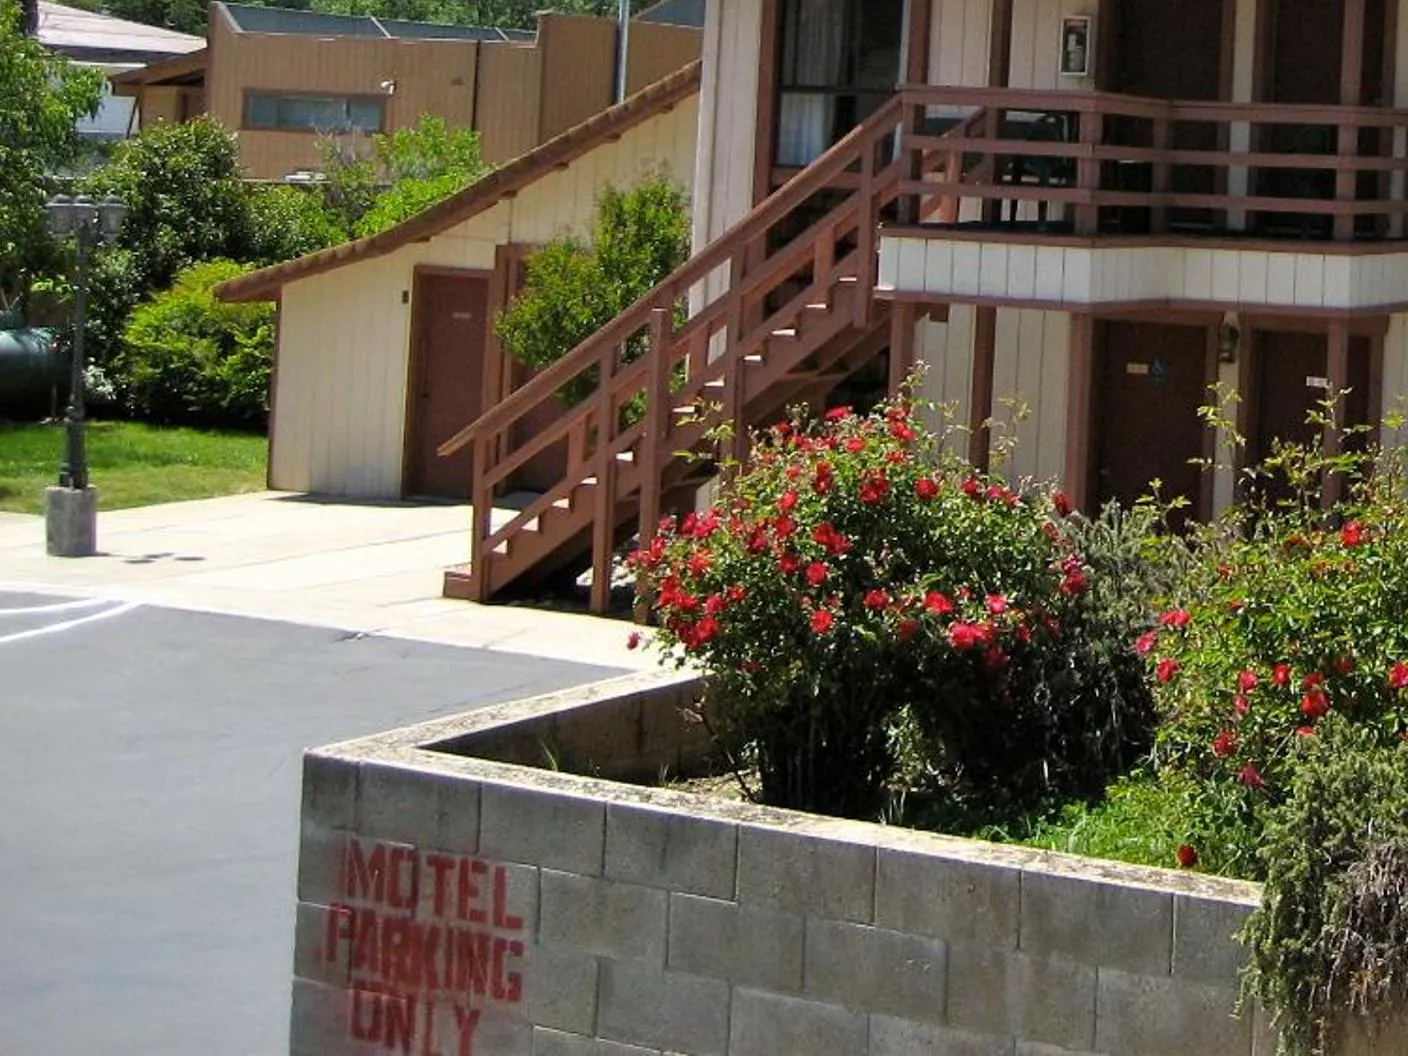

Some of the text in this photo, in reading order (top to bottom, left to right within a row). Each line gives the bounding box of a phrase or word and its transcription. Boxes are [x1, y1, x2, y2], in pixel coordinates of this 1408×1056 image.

[341, 839, 524, 930] MOTEL
[325, 902, 525, 1002] PARKING
[350, 978, 480, 1056] ONLY
